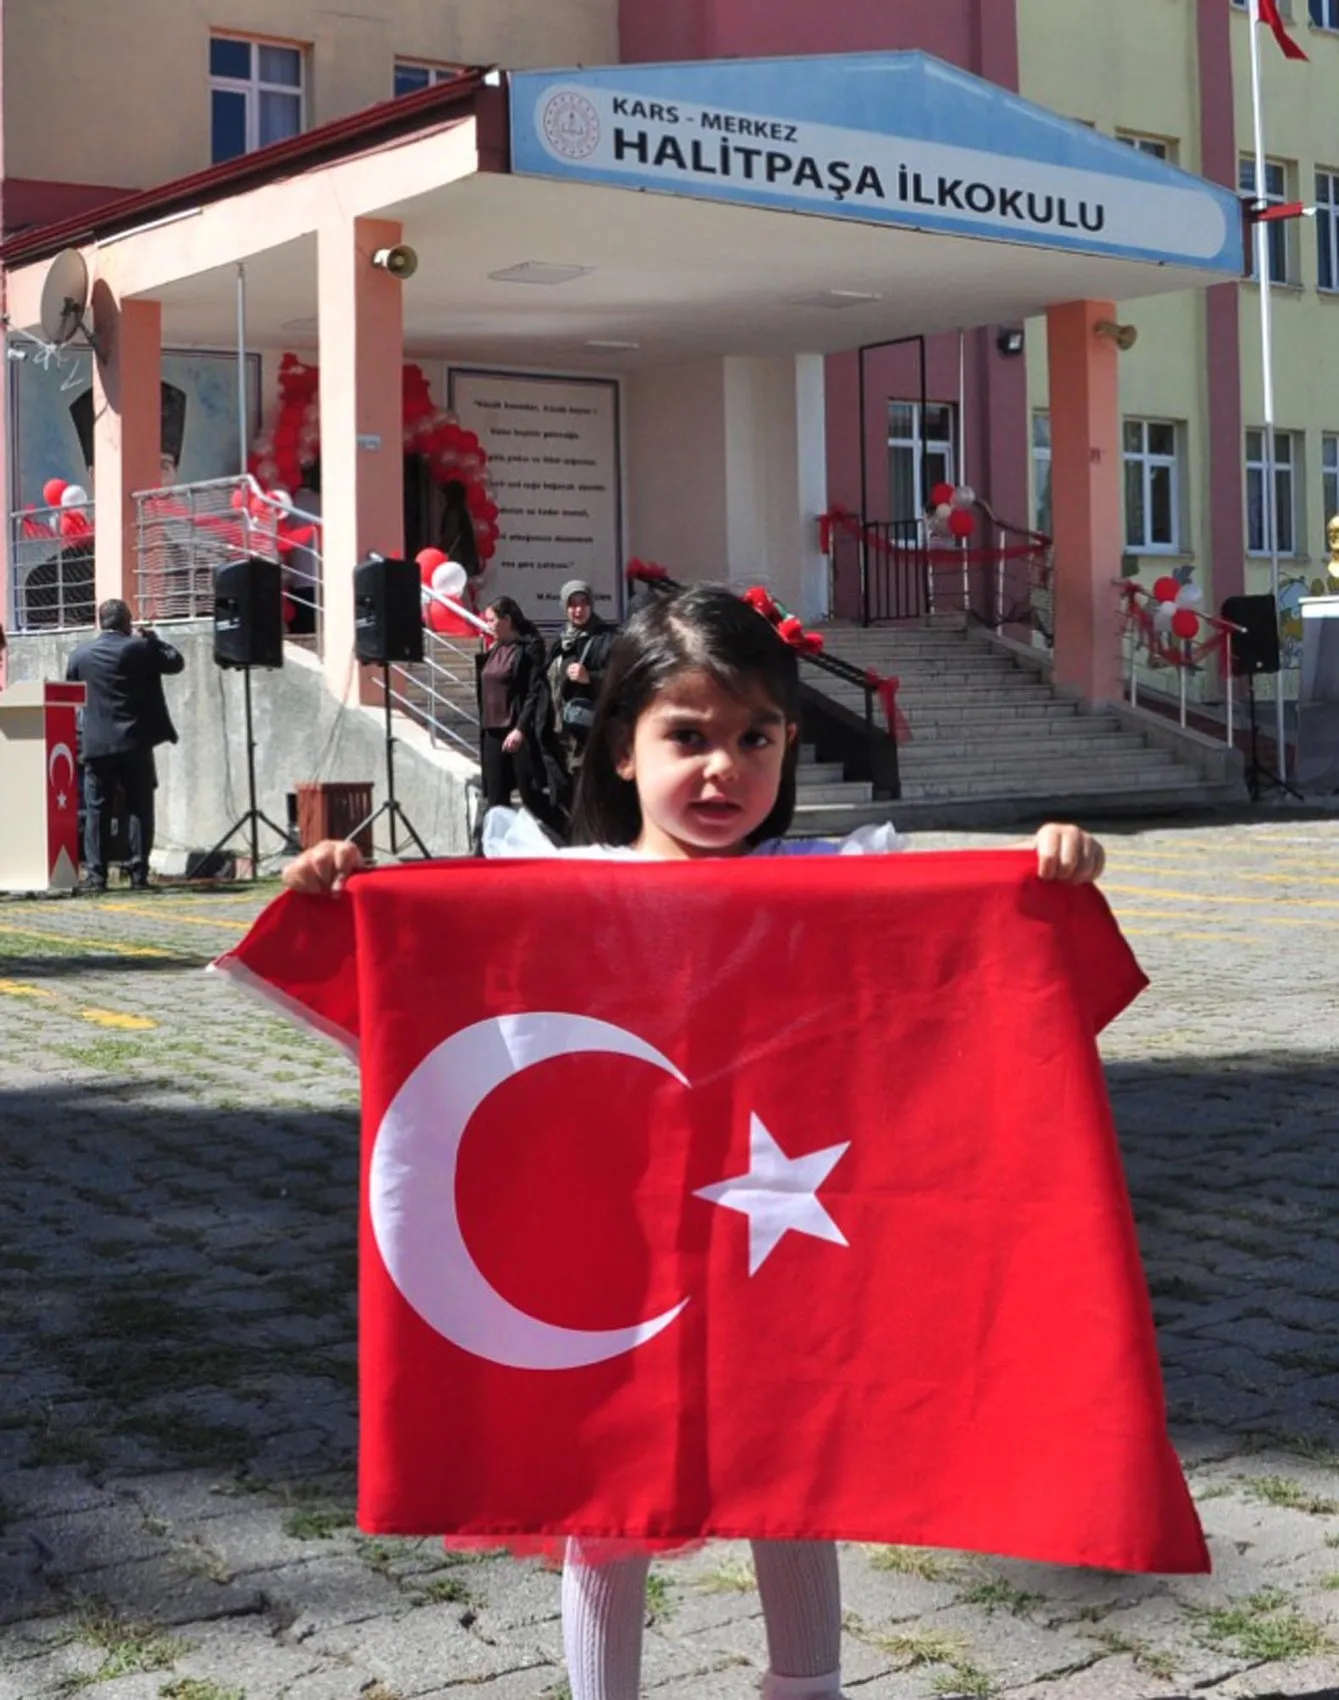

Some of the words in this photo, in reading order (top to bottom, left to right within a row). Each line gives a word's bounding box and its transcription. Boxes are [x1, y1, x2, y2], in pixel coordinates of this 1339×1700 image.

[613, 97, 679, 123] KARS
[701, 112, 798, 143] MERKEZ
[613, 127, 885, 201] HALİTPAŞA
[898, 163, 1104, 232] İLKOKULU
